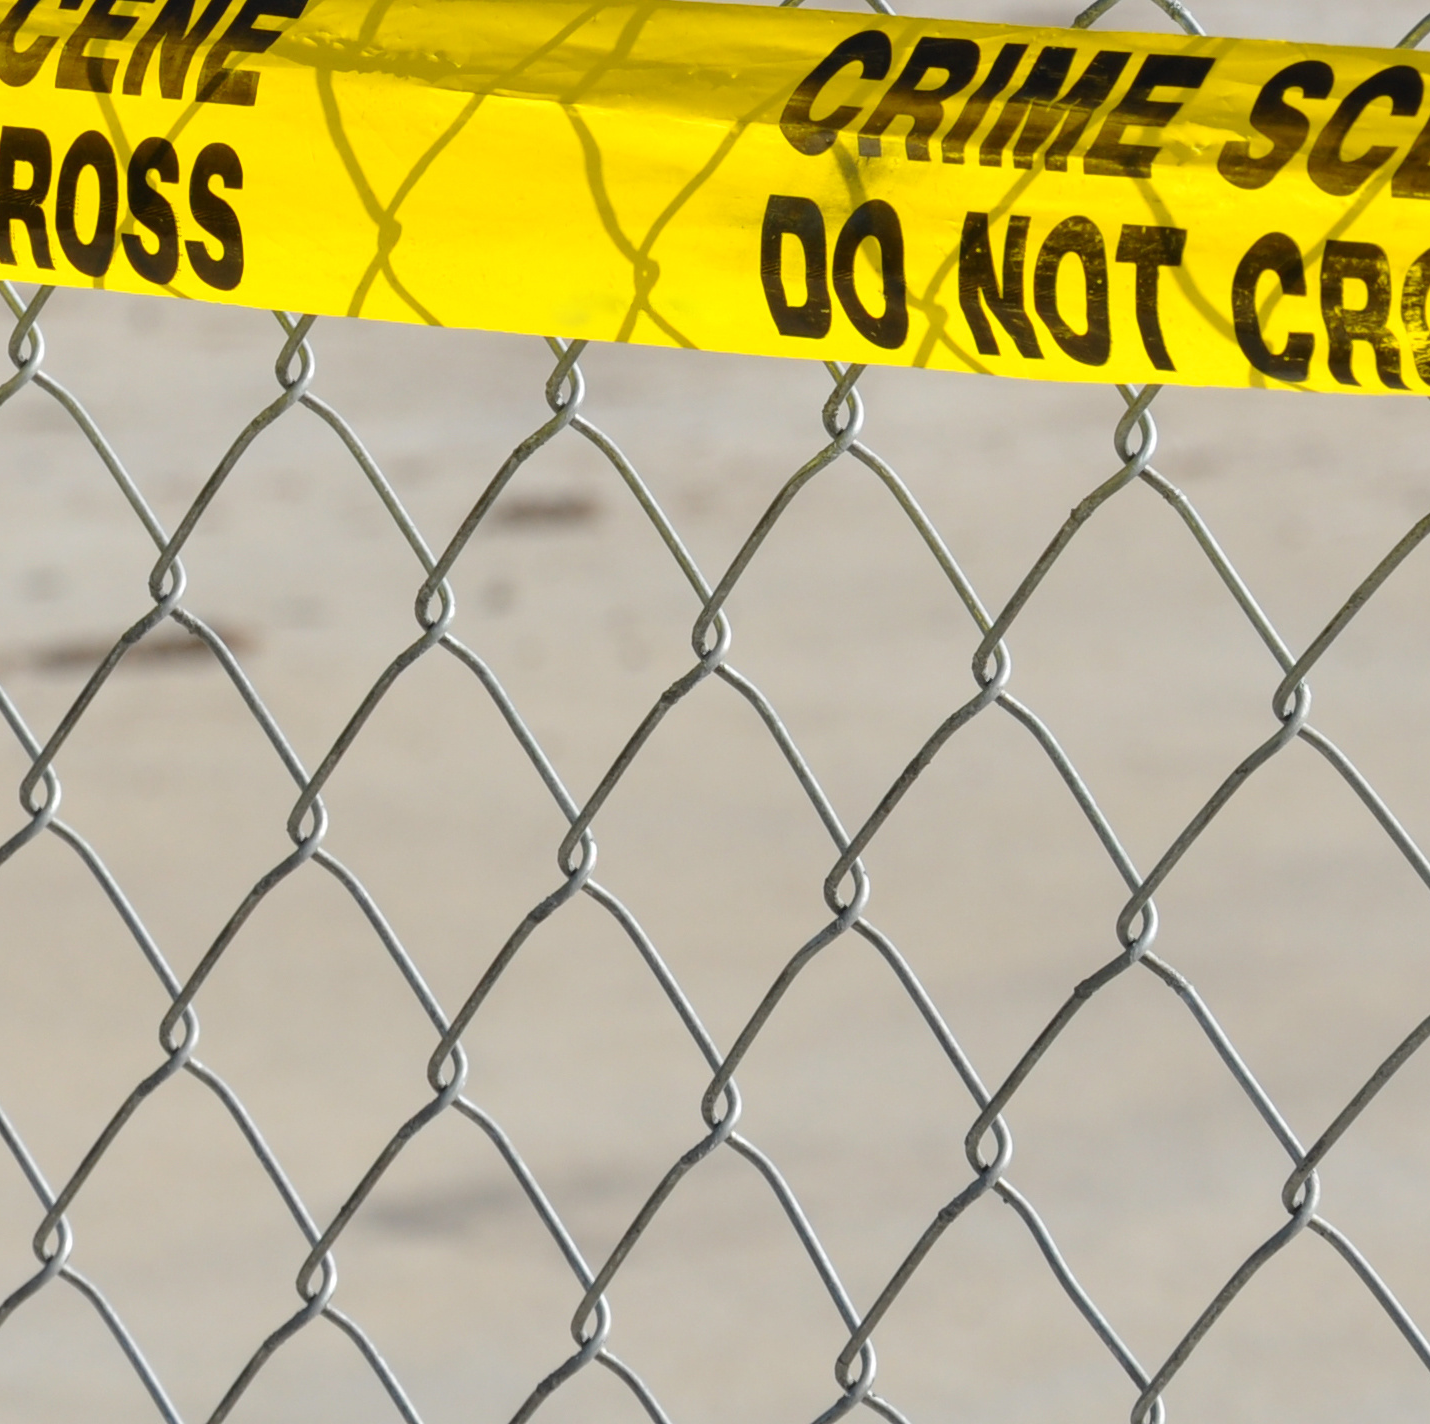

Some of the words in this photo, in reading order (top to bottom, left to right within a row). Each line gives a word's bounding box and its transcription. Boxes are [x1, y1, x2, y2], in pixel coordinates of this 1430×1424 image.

[778, 30, 1215, 178] CRIME
[761, 194, 908, 349] DO
[959, 210, 1187, 372] NOT
